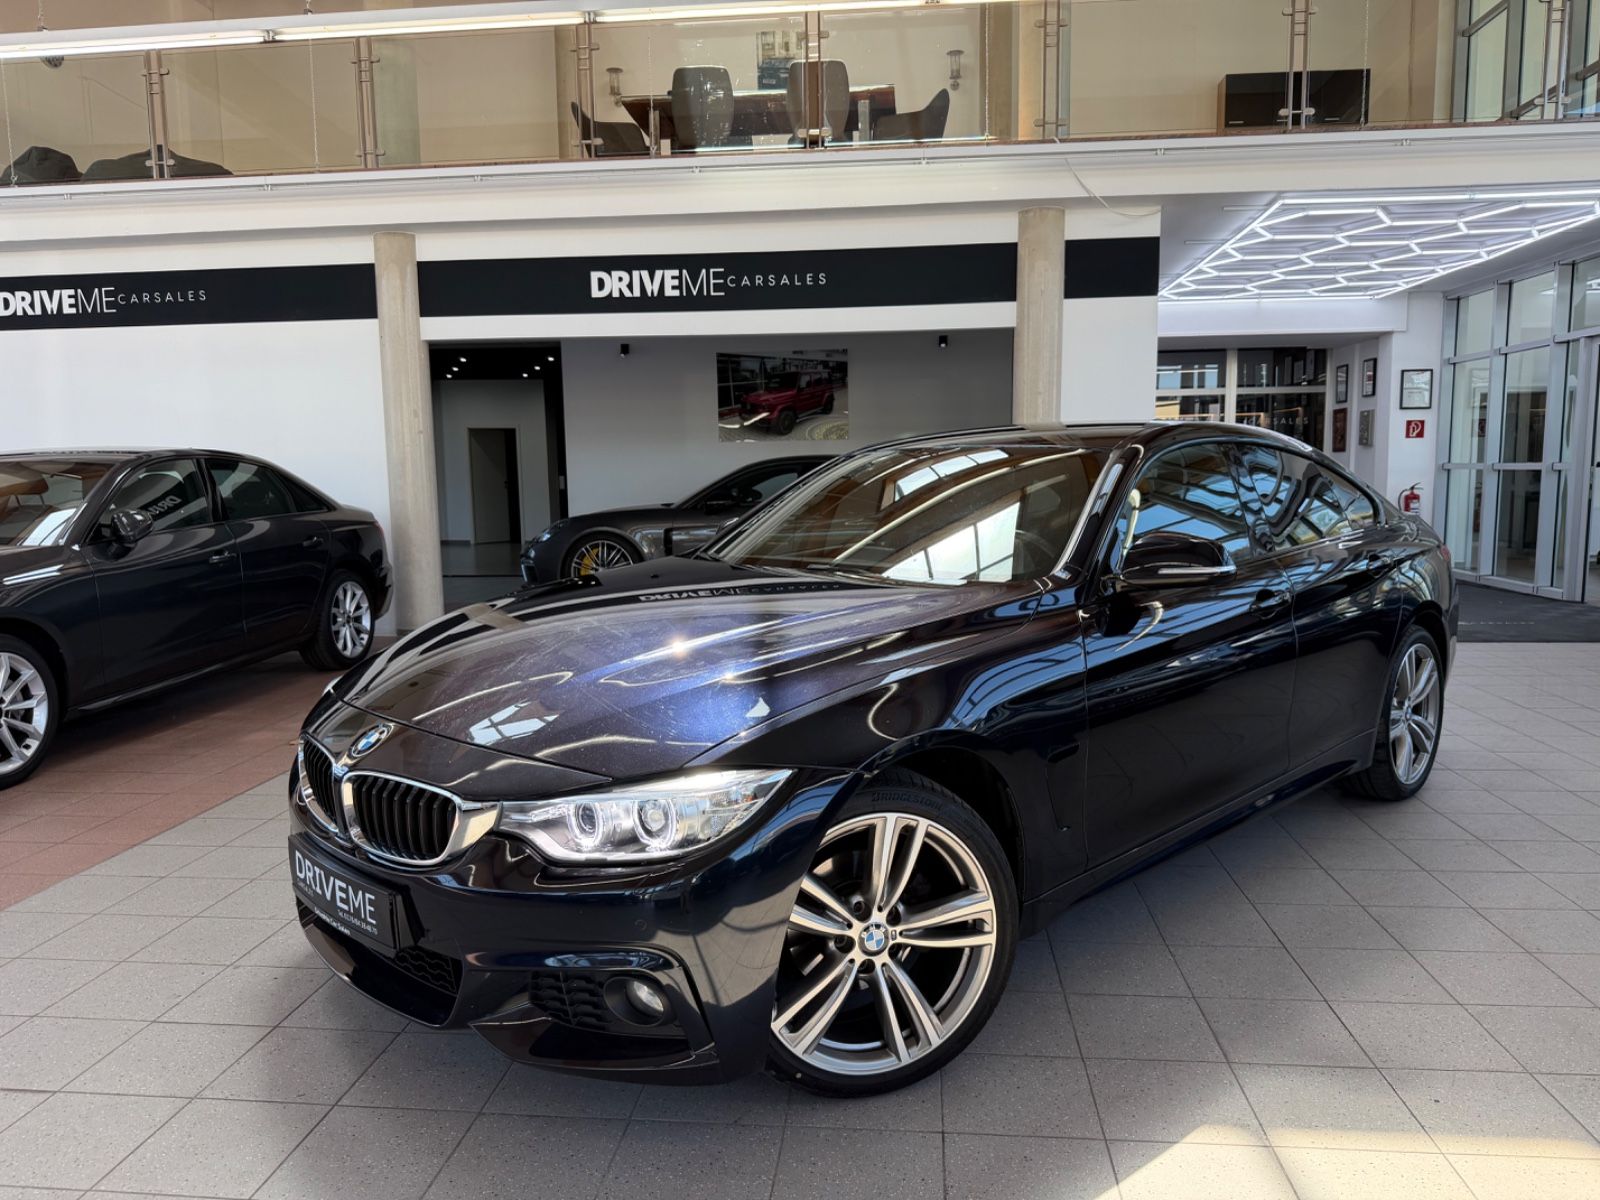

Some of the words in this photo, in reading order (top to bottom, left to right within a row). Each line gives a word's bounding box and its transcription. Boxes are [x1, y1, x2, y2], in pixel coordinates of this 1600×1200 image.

[590, 268, 725, 298] DRIVEME
[727, 273, 827, 288] CARSALES
[0, 287, 117, 316] DRIVEME
[118, 290, 207, 305] CARSALES
[295, 850, 376, 924] DRIVEME
